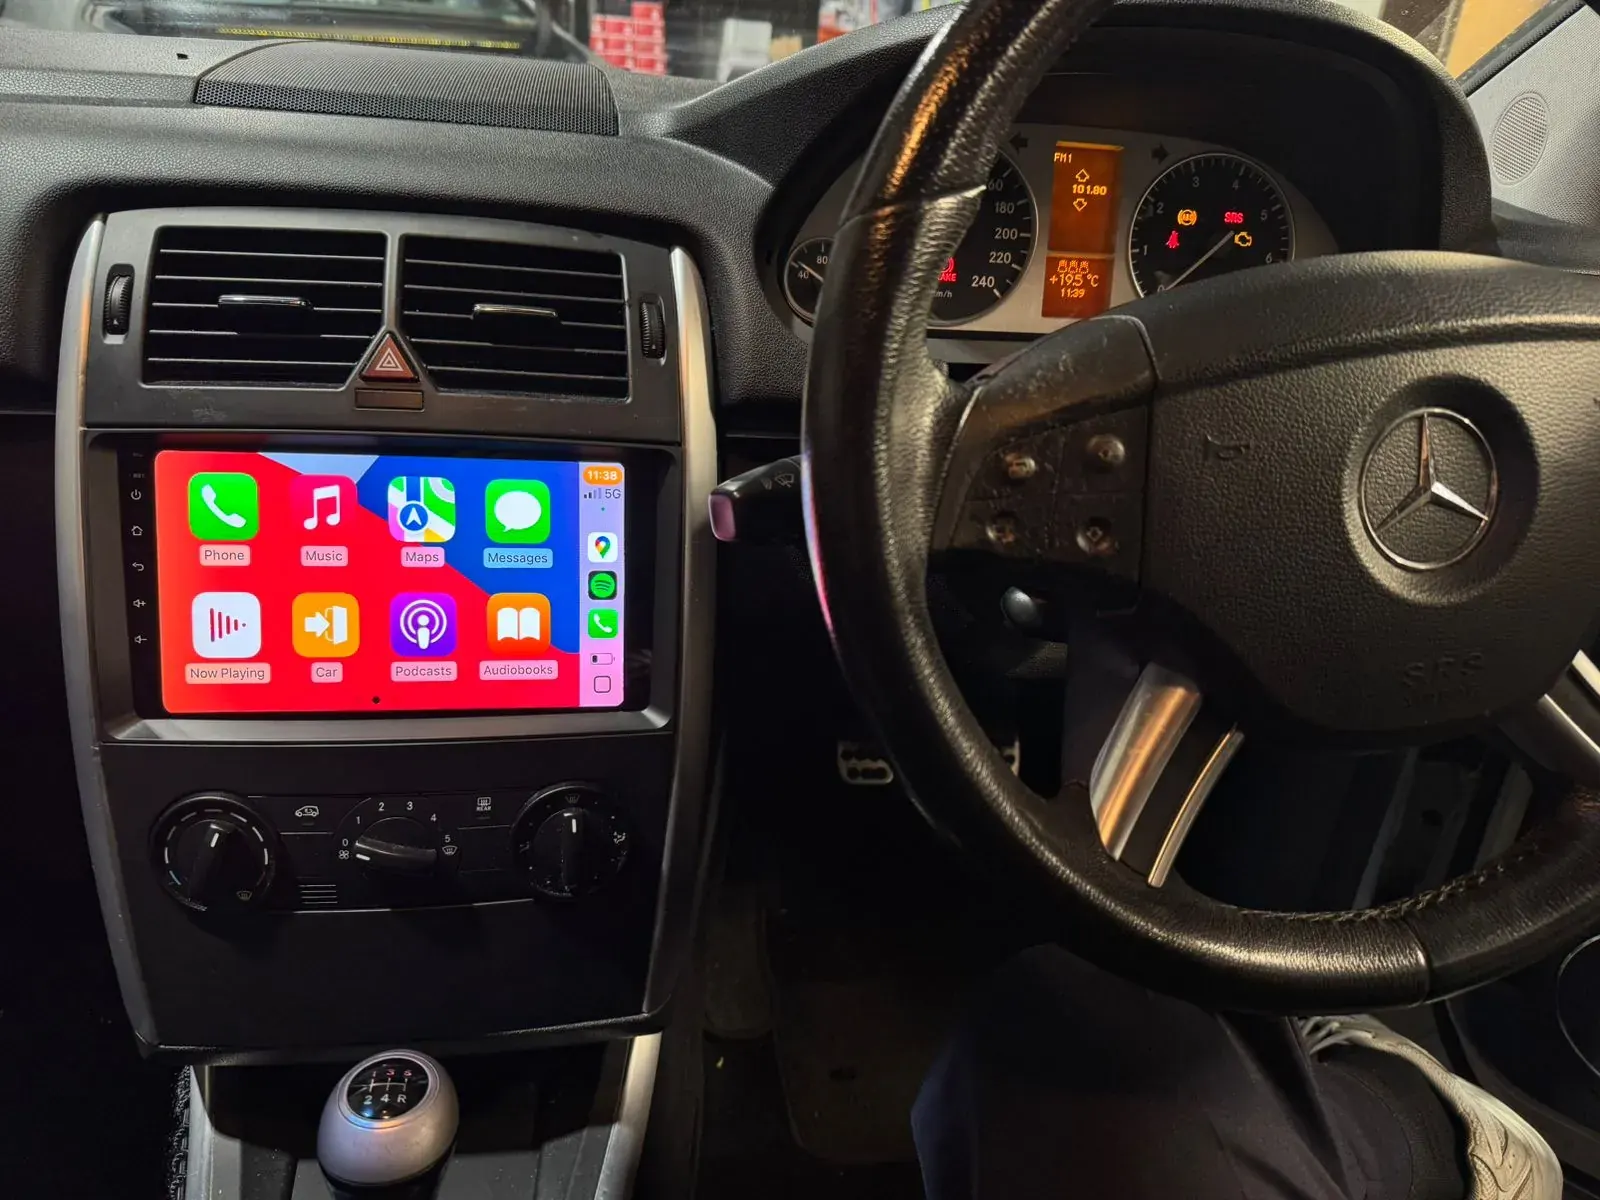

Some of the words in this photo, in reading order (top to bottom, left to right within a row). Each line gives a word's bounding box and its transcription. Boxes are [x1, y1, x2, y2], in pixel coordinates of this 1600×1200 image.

[1053, 152, 1072, 164] FM1
[1192, 176, 1200, 187] 3
[1232, 180, 1241, 190] 4
[994, 201, 1015, 214] 180
[1156, 202, 1164, 214] 2
[1224, 211, 1244, 224] SRS
[1260, 209, 1268, 221] 5
[994, 228, 1018, 240] 200
[816, 255, 828, 264] 80
[989, 251, 1011, 264] 220
[1265, 253, 1273, 264] 6
[937, 273, 957, 282] AKE
[971, 275, 994, 288] 240
[587, 470, 617, 481] 11:38
[605, 488, 621, 499] 5G
[203, 549, 245, 561] Phone
[305, 550, 343, 562] Music
[405, 551, 440, 565] Maps
[487, 552, 548, 566] Messages
[190, 668, 218, 679] Now
[220, 667, 265, 681] Playing
[315, 667, 338, 678] Car
[395, 666, 452, 677] Podcasts
[483, 665, 553, 676] Audiobooks
[378, 802, 384, 811] 2
[405, 801, 412, 810] 3
[355, 816, 360, 824] 1
[429, 814, 436, 822] 4
[444, 835, 450, 843] 5
[363, 1094, 373, 1105] 2
[380, 1093, 391, 1103] 4
[397, 1094, 407, 1103] R
